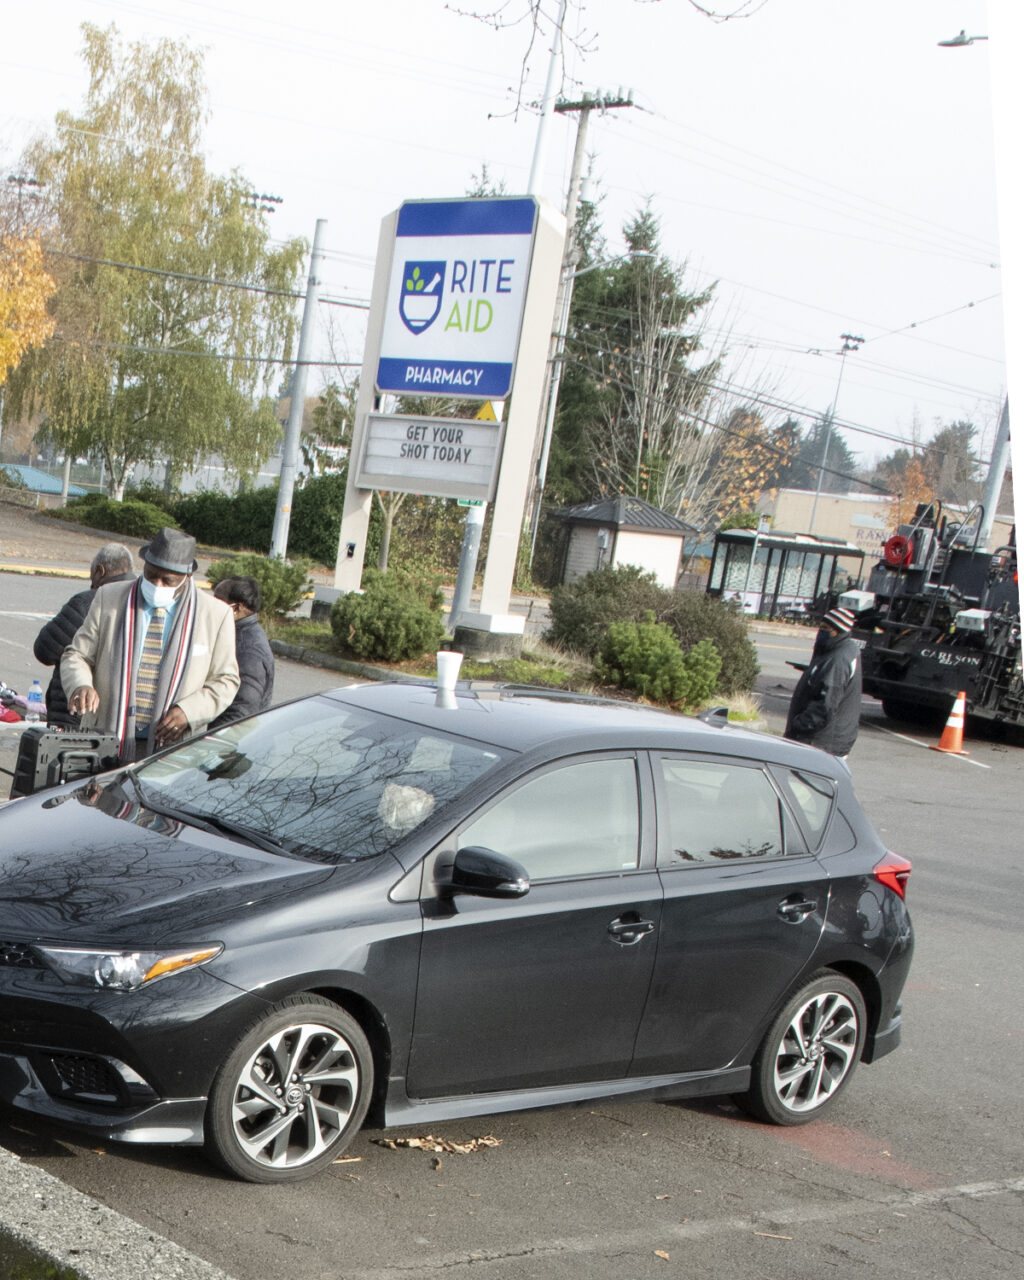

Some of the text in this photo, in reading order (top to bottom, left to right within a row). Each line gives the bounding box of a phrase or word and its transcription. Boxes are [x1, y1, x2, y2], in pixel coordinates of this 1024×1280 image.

[450, 259, 516, 294] RITE
[444, 299, 494, 333] AID
[405, 366, 484, 387] PHARMACY
[407, 425, 464, 444] GET YOUR
[400, 443, 472, 464] SHOT TODAY
[920, 648, 981, 666] CARLSON
